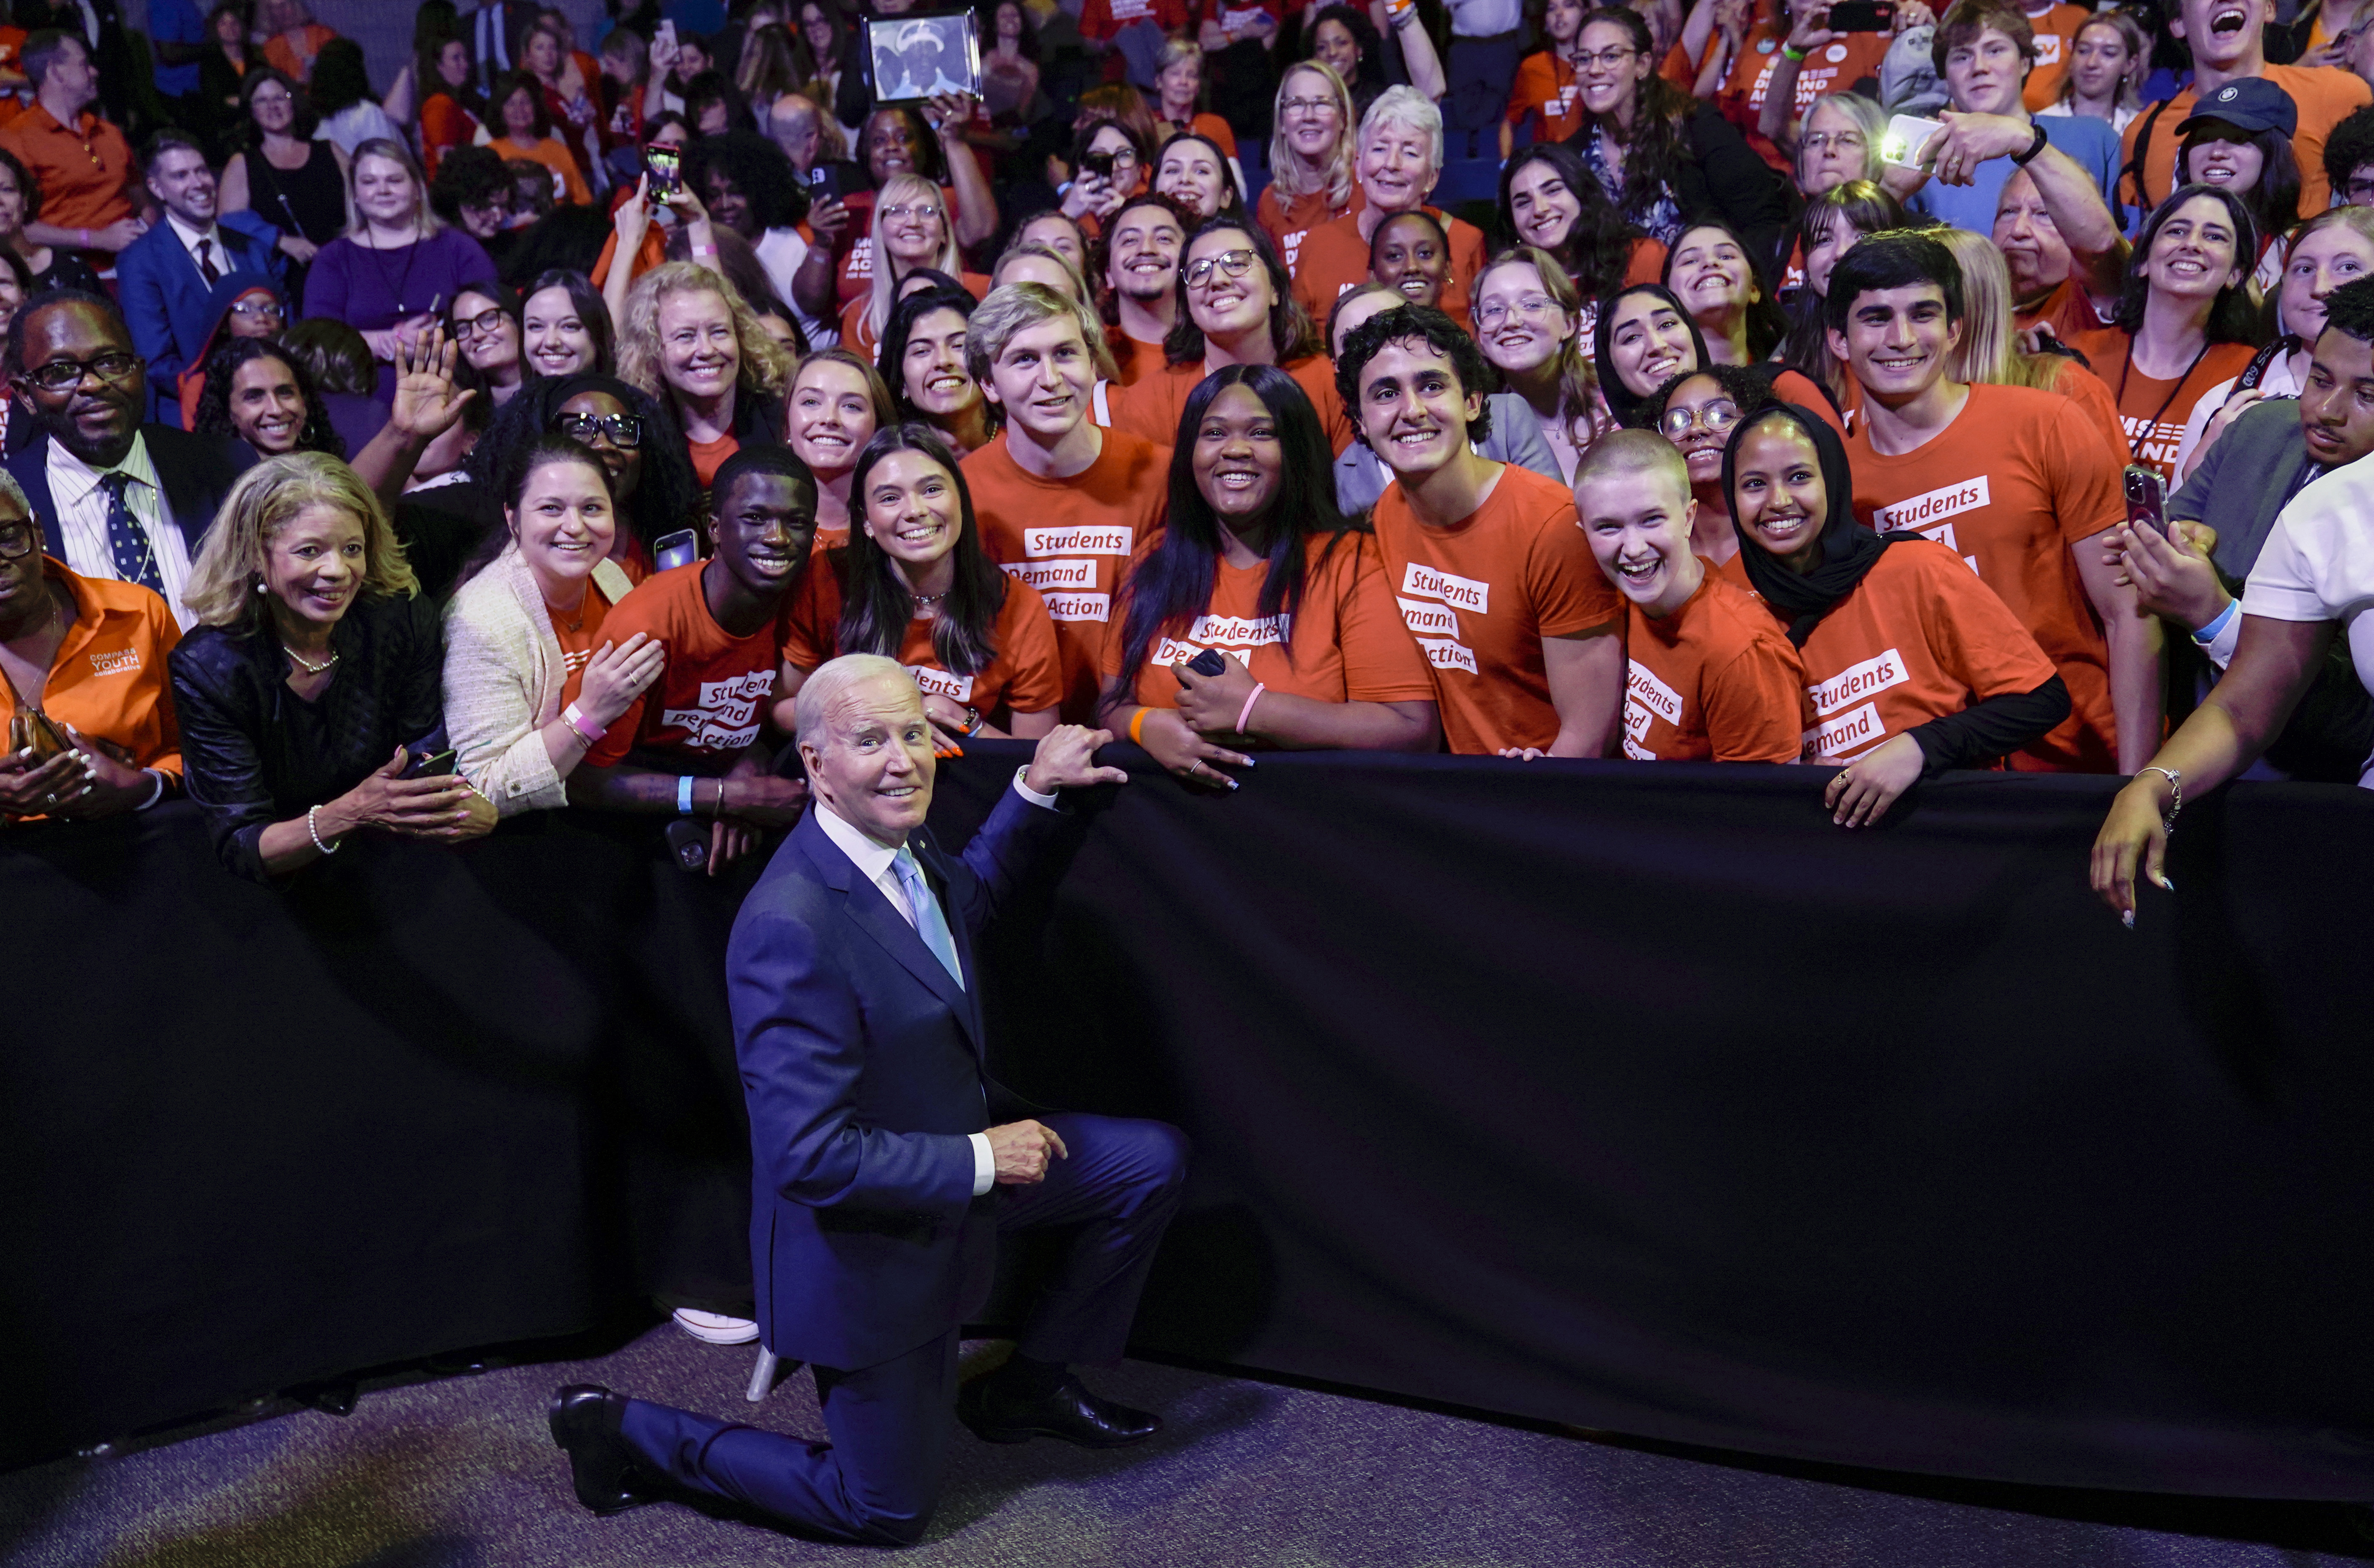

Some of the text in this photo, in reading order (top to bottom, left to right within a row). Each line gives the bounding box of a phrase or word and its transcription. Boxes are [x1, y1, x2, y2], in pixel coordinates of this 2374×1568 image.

[1883, 488, 1978, 531] Students
[1034, 531, 1123, 551] Students
[1048, 598, 1103, 615] Action
[1200, 621, 1279, 640] Students
[91, 654, 139, 671] YOUTH
[1421, 644, 1471, 669] ction
[94, 664, 141, 677] collaborative
[1809, 663, 1894, 713] Students
